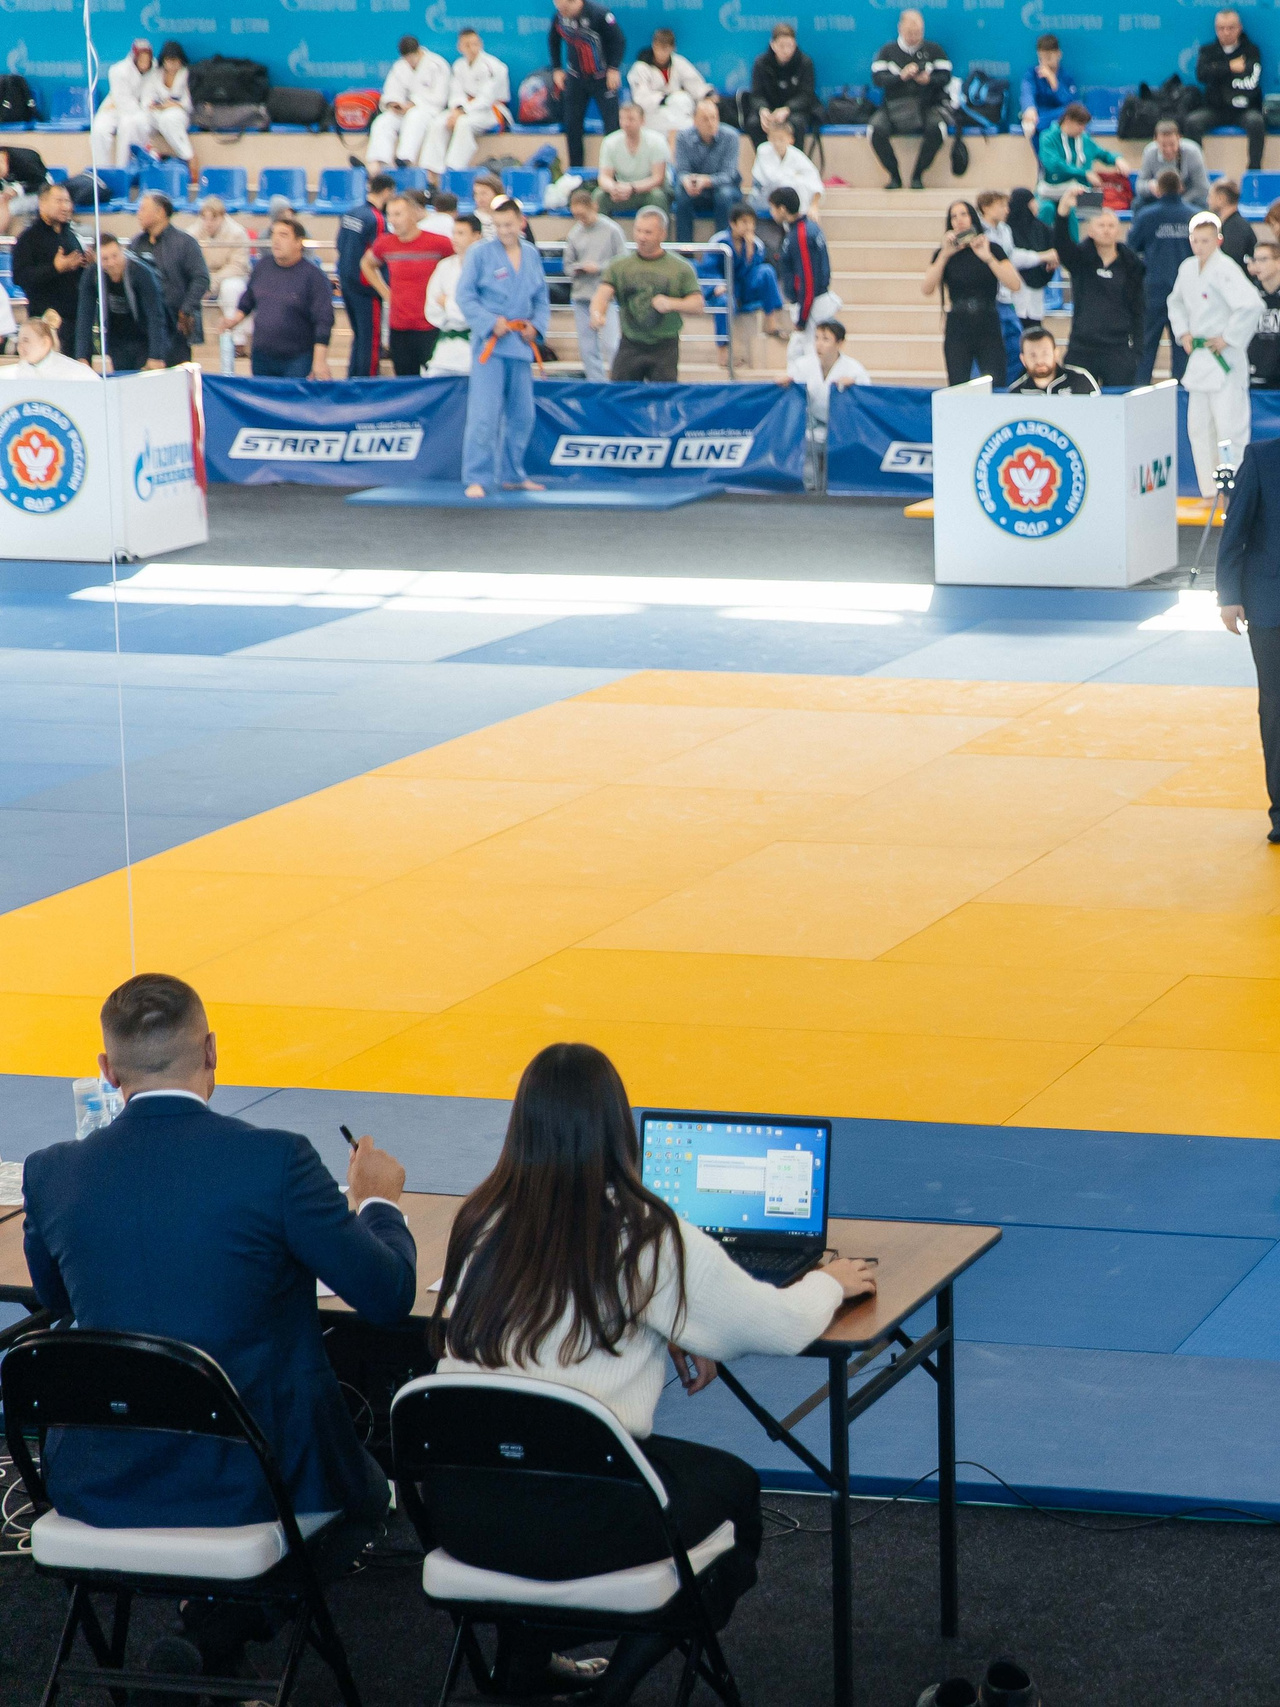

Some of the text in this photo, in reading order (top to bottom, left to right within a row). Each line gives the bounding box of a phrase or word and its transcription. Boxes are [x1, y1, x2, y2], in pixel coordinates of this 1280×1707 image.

[239, 435, 413, 457] START LINE
[560, 442, 743, 461] START LINE
